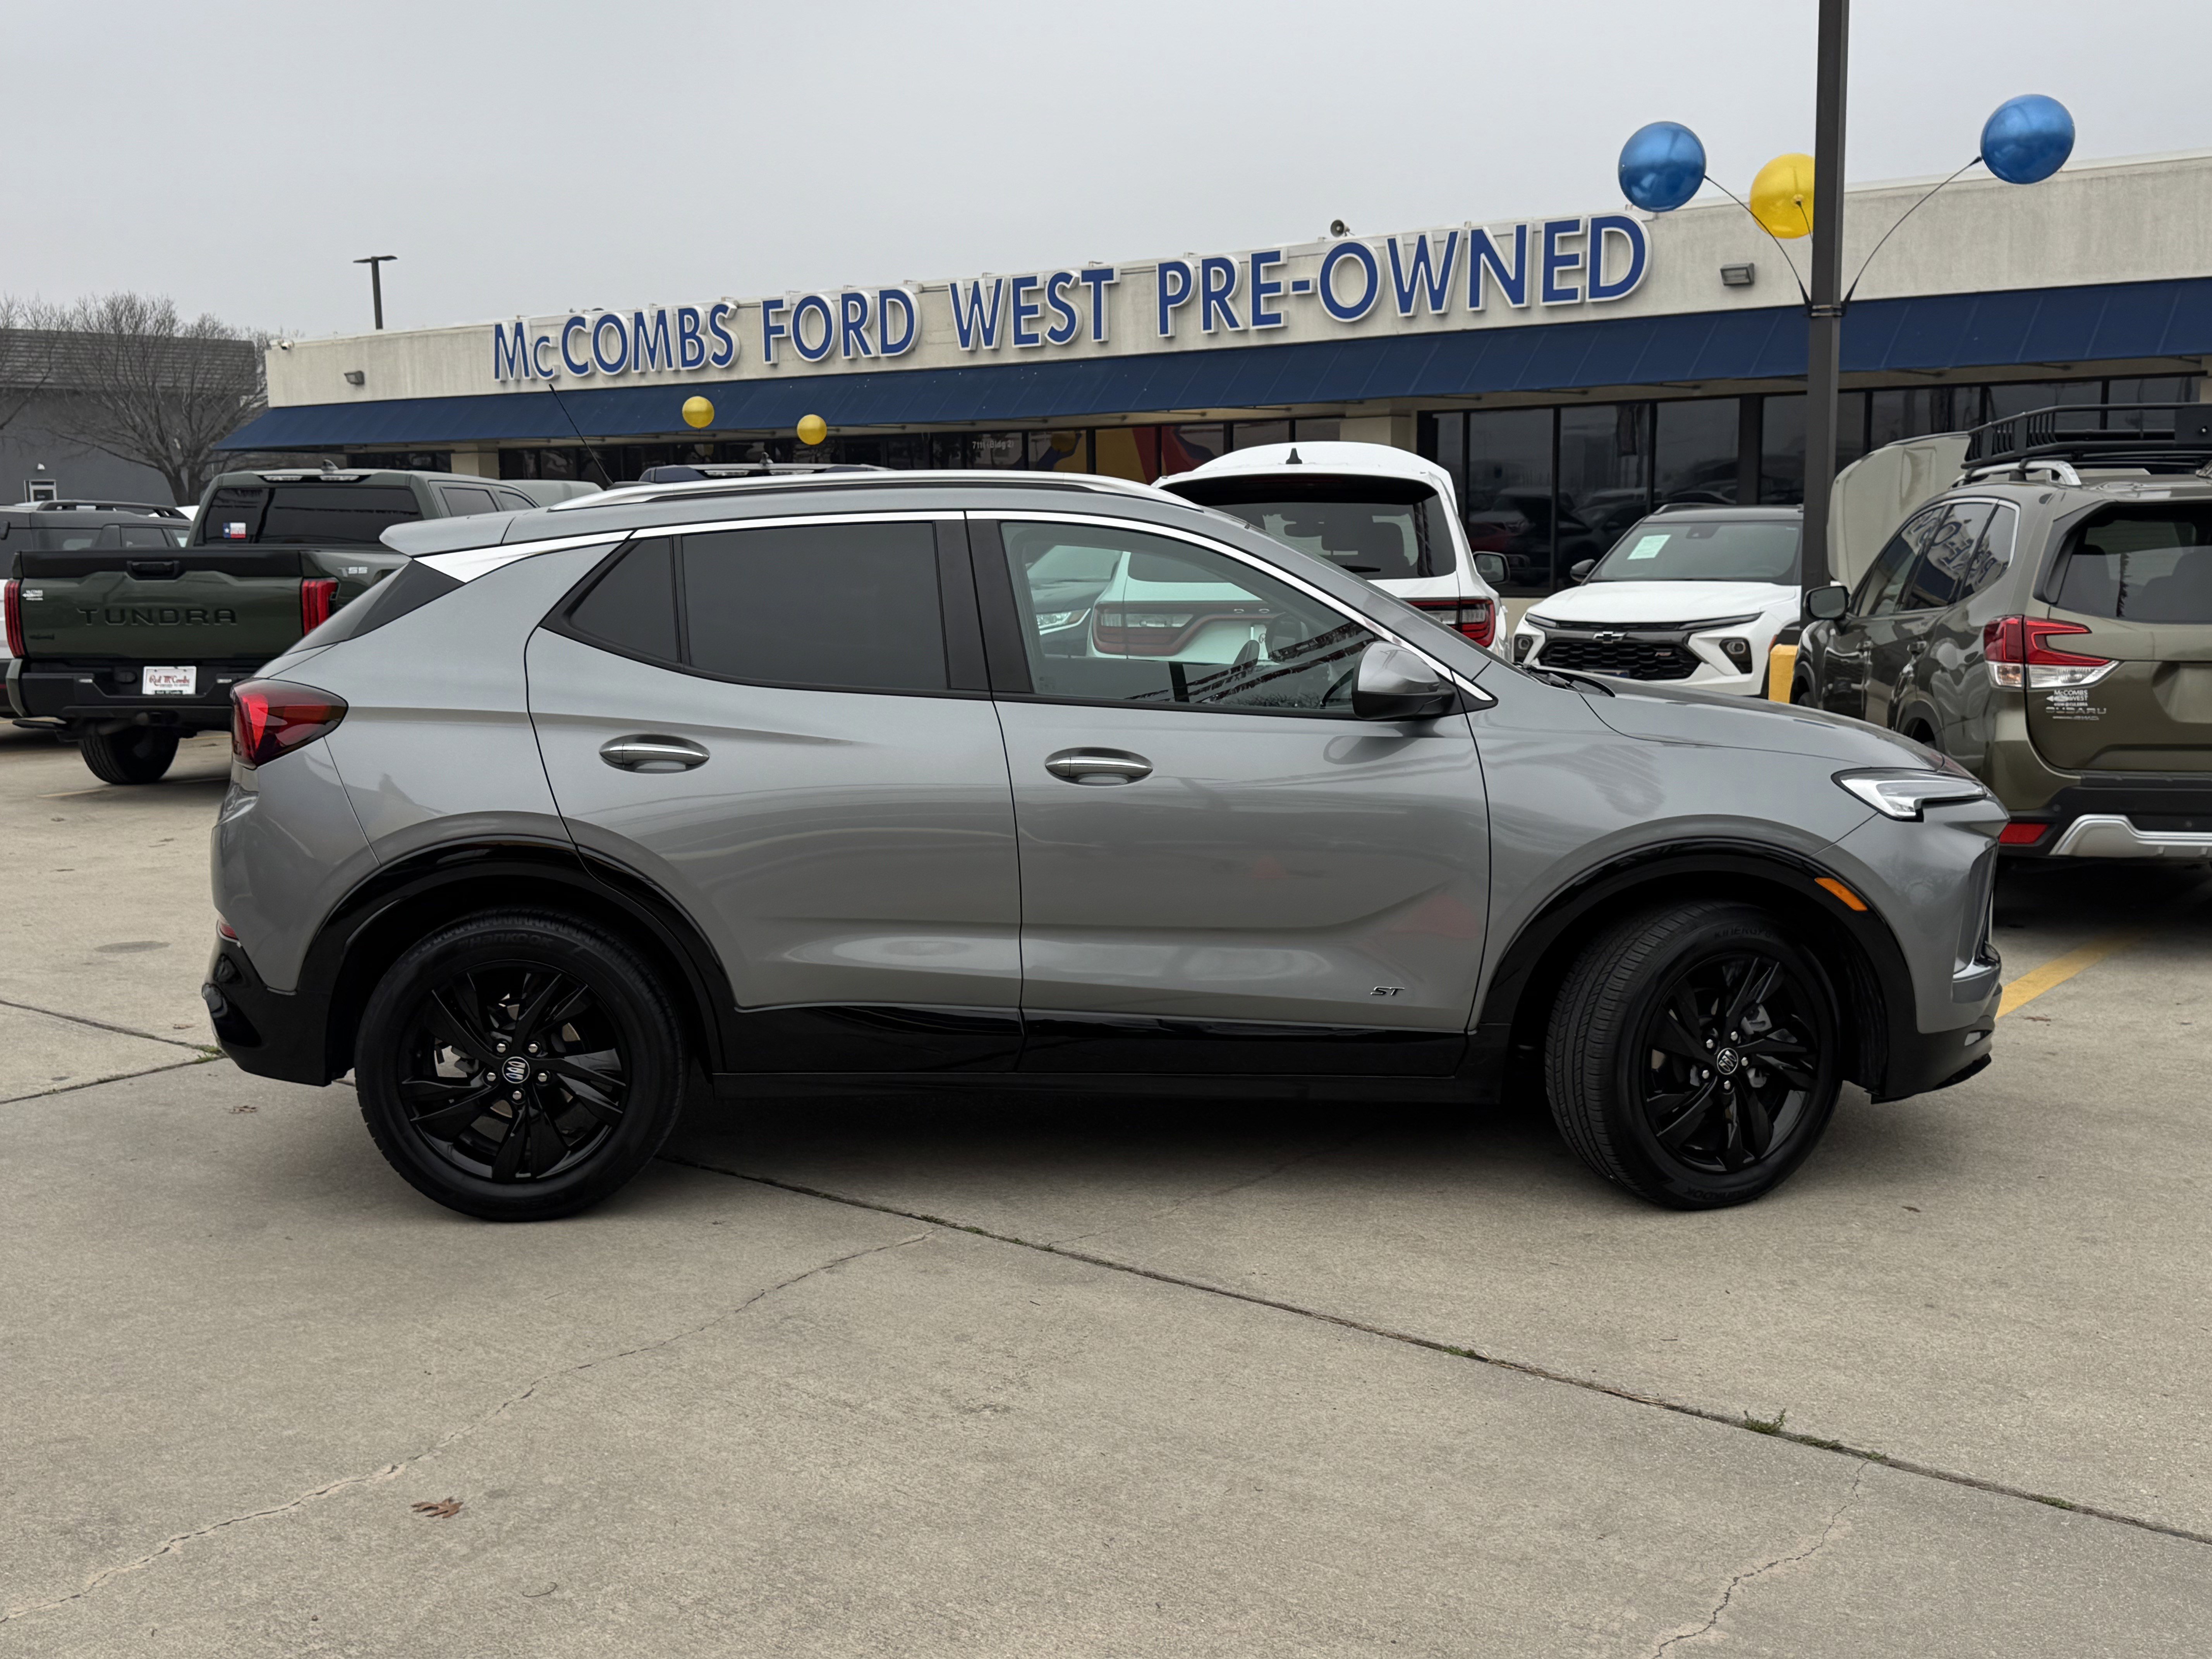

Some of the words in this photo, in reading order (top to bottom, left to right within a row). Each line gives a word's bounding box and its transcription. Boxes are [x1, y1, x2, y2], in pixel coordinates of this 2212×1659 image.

[494, 301, 739, 381] McCOMBS
[761, 287, 921, 365] FORD
[948, 266, 1119, 351] WEST
[1156, 213, 1652, 338] PRE-OWNED
[77, 608, 238, 626] TUNDRA
[1370, 986, 1405, 996] ST
